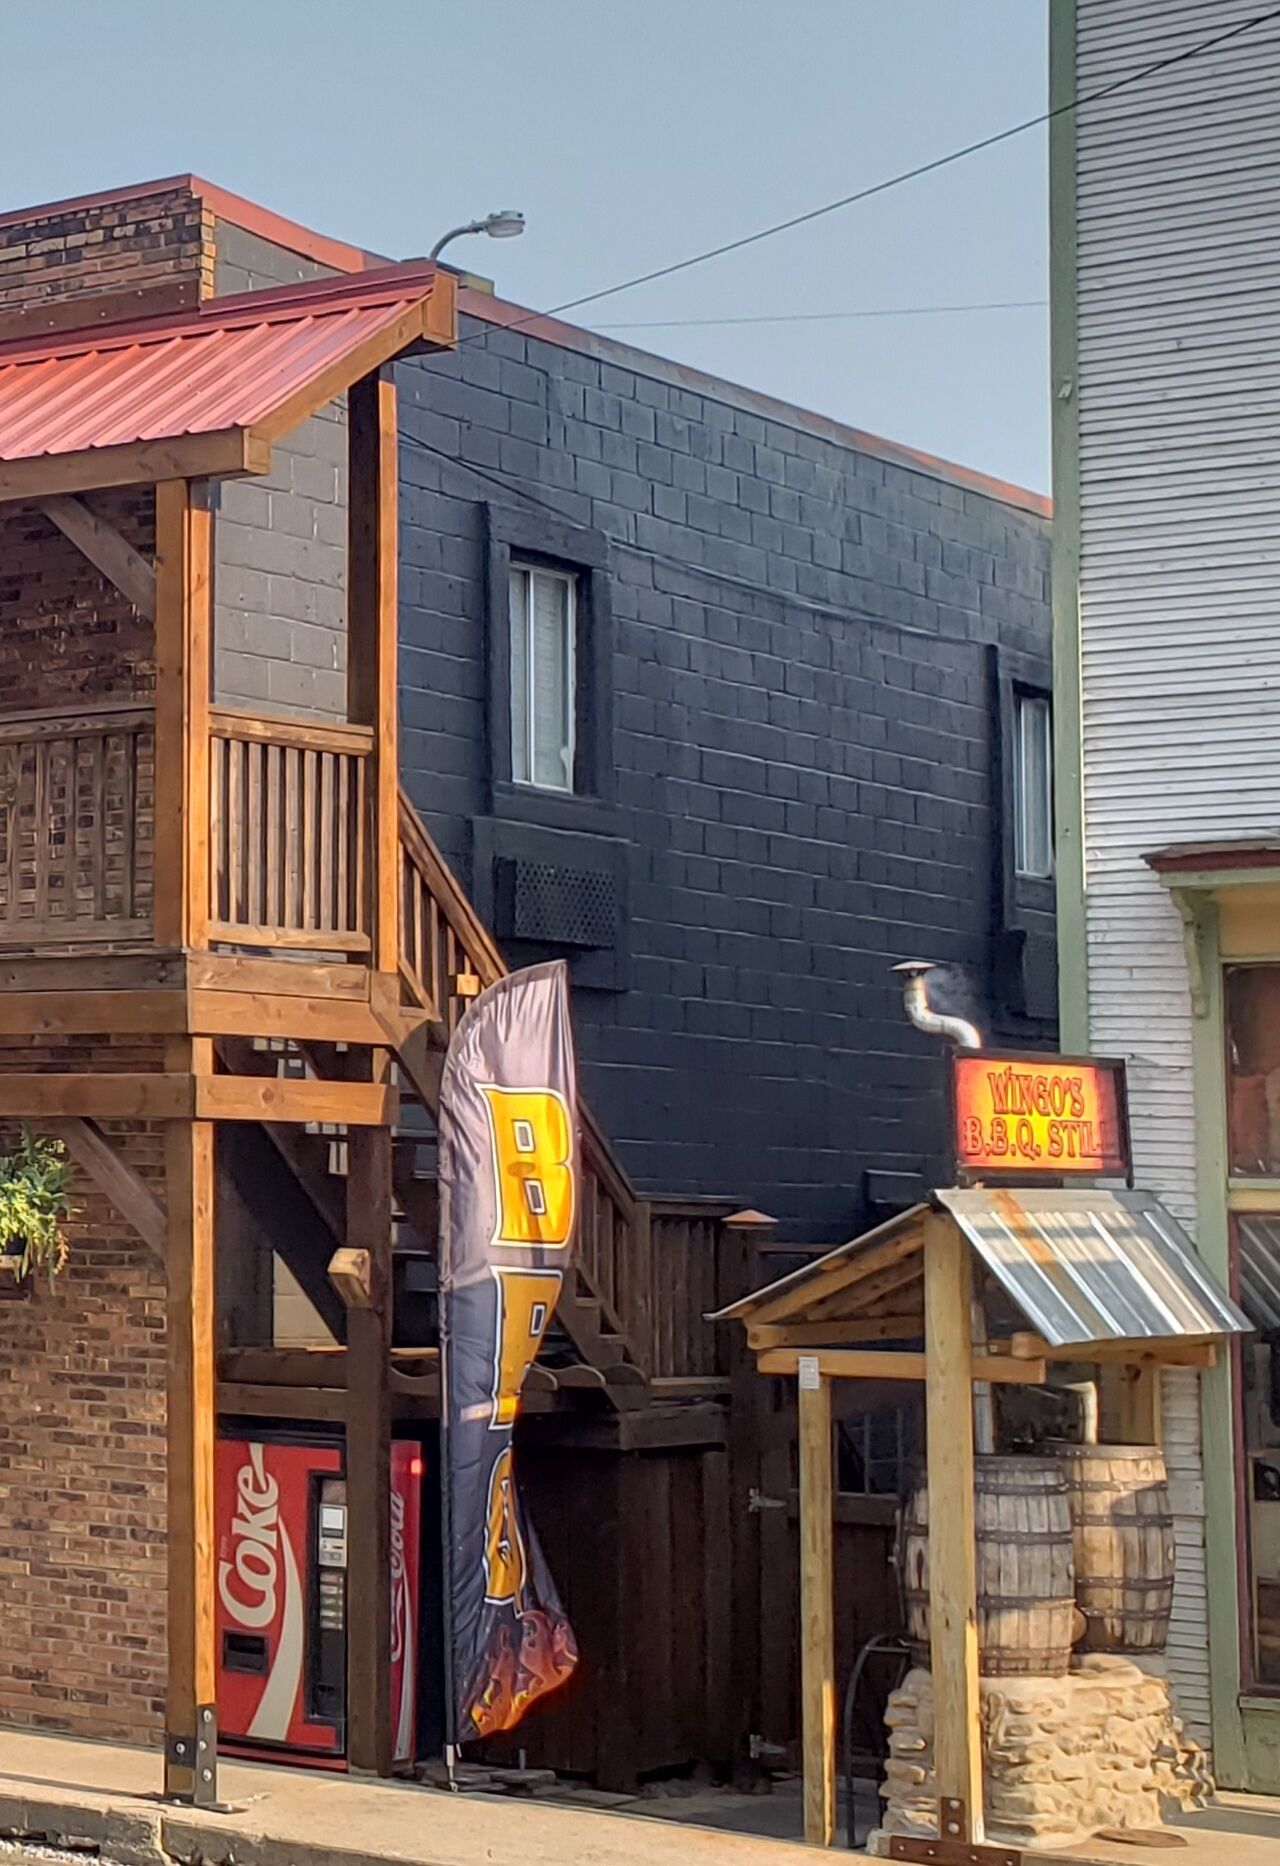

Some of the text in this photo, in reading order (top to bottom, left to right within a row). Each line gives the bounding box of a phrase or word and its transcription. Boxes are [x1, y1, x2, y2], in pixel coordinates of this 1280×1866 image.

[987, 1065, 1085, 1118] WINGO'S
[965, 1116, 1042, 1161] B.B.Q.
[219, 1444, 279, 1628] Coke
